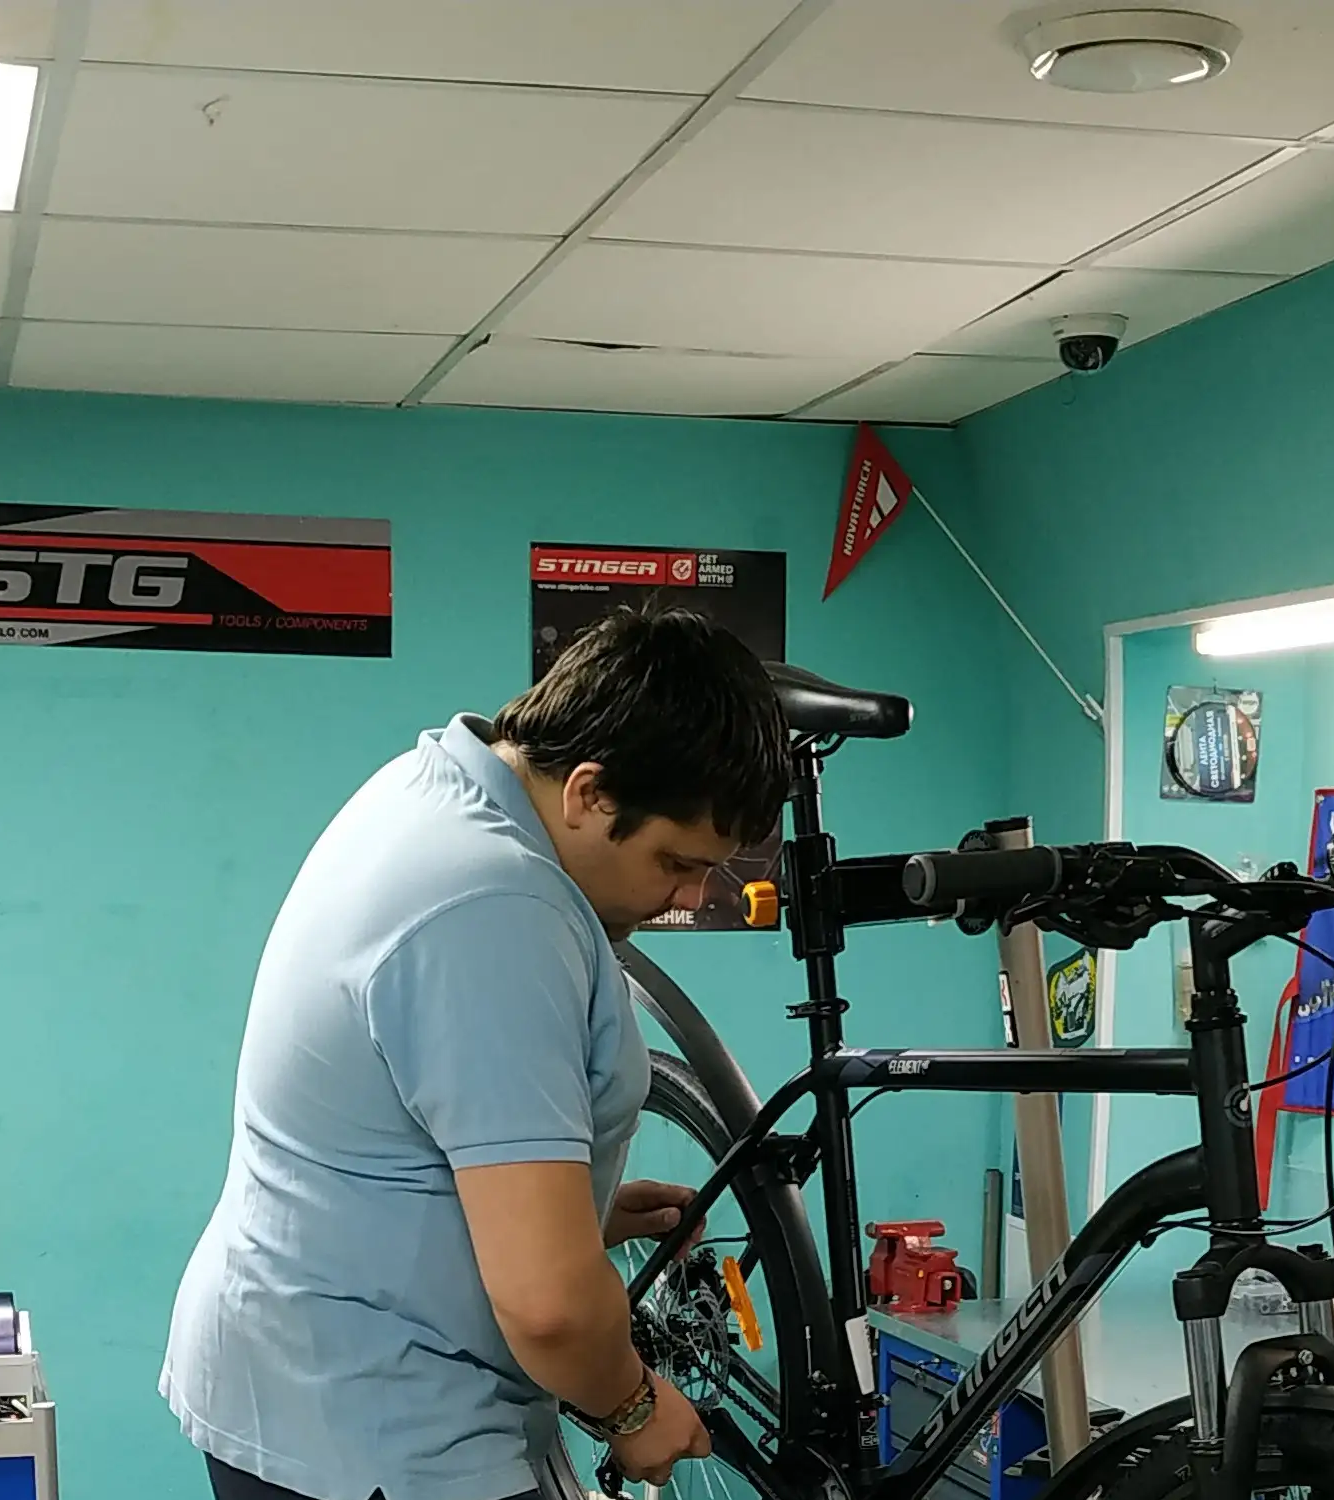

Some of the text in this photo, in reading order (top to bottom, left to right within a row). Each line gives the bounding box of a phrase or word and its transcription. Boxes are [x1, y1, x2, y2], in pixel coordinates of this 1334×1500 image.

[842, 458, 873, 557] NOVATRACK
[537, 558, 658, 577] STINGER
[698, 554, 719, 564] GET
[698, 563, 734, 575] ARMED
[698, 574, 725, 584] WITH
[218, 614, 262, 627] TOOLS
[274, 616, 369, 632] COMPONENTS
[923, 1260, 1068, 1449] STINGER
